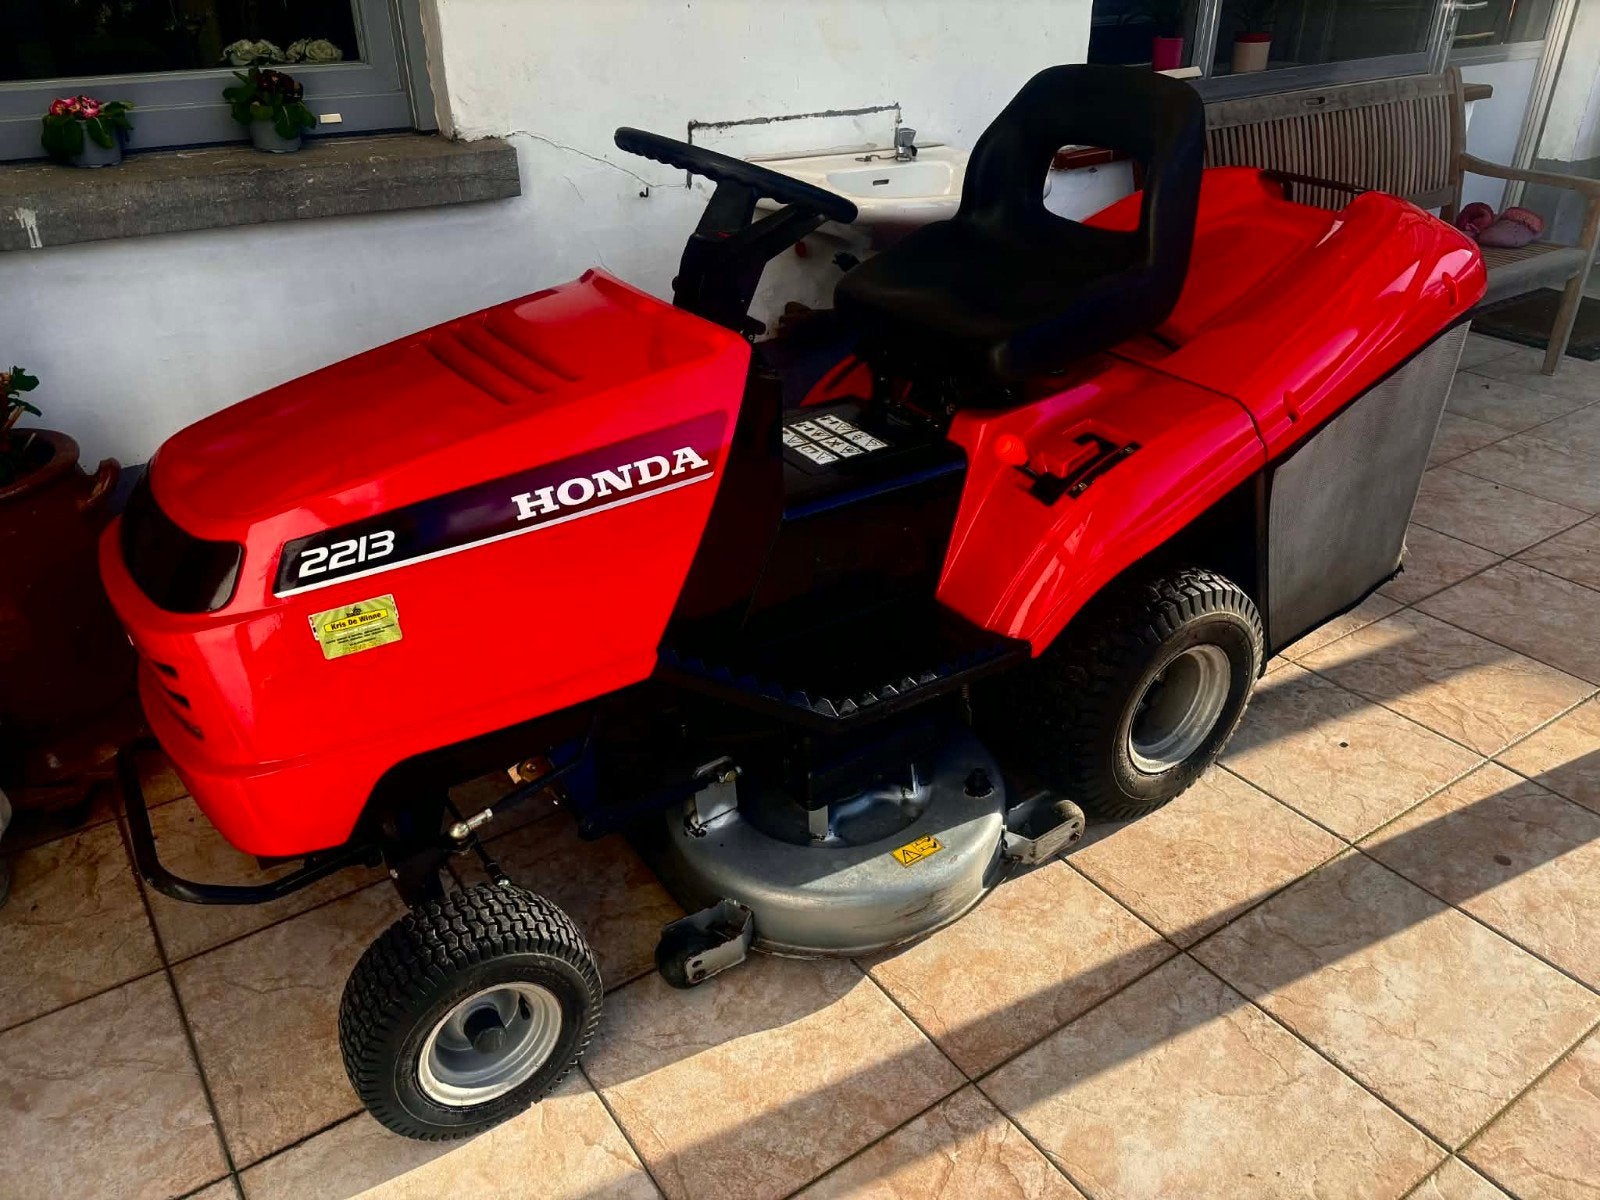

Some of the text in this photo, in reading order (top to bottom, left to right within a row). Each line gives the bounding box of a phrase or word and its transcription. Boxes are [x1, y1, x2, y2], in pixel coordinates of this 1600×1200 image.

[511, 446, 708, 521] HONDA
[298, 530, 395, 577] 2213
[330, 622, 346, 631] Kris
[348, 618, 358, 626] De
[360, 612, 382, 622] Winne
